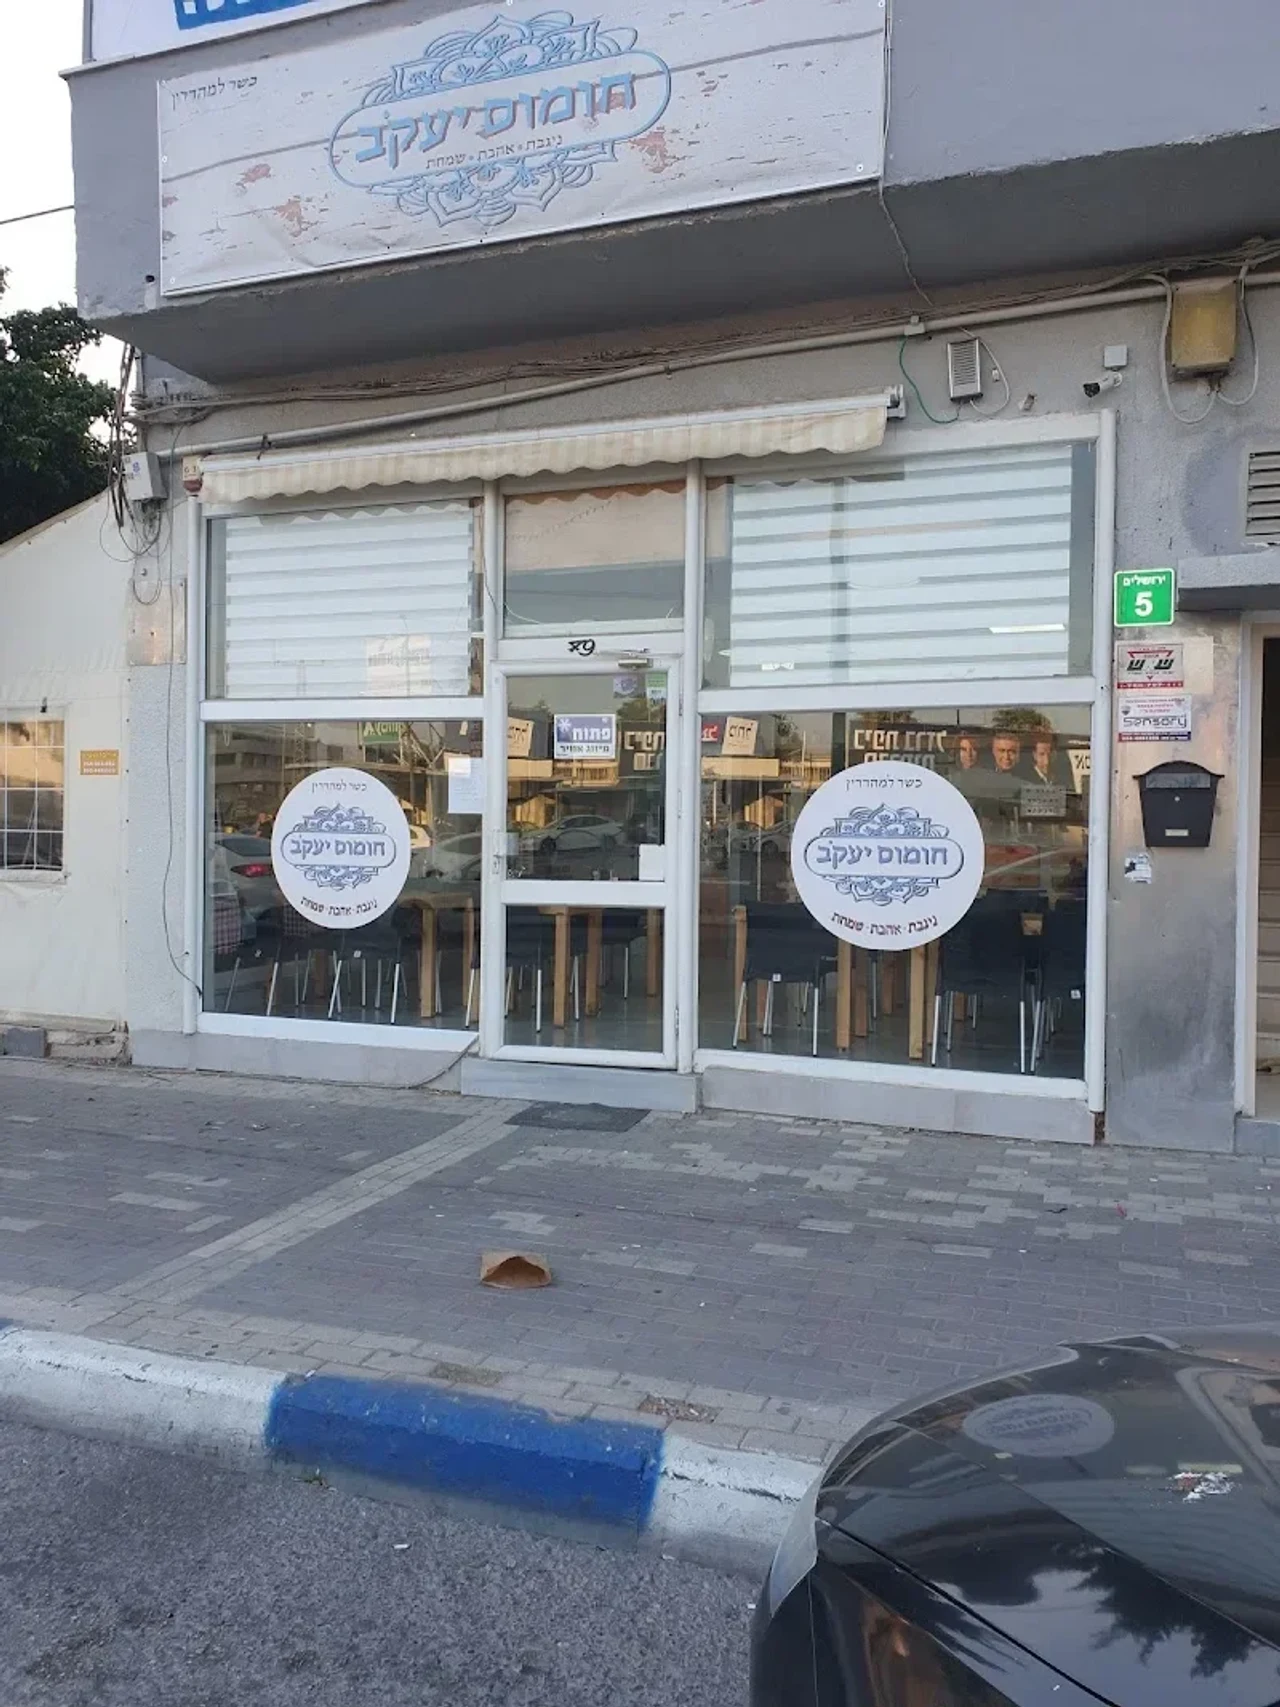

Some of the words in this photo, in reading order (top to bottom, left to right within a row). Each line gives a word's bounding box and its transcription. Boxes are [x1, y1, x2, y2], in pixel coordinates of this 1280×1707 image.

[228, 76, 258, 90] כשר
[171, 77, 226, 112] למהדרין
[475, 70, 637, 139] חומוס
[526, 134, 563, 151] ניגבת
[477, 143, 515, 162] אהבת
[425, 153, 467, 170] שמחת
[1123, 574, 1166, 587] ירושלים
[1134, 591, 1153, 617] 5
[572, 727, 611, 741] פתוח
[311, 779, 347, 794] למהדרין
[348, 781, 368, 792] כשר
[845, 775, 895, 791] למהדרין
[897, 777, 923, 789] כשר
[334, 839, 386, 857] חומוס
[876, 845, 948, 866] חומוס
[831, 912, 865, 931] שמחת
[870, 922, 902, 936] אהבת
[908, 915, 938, 934] ניגבת
